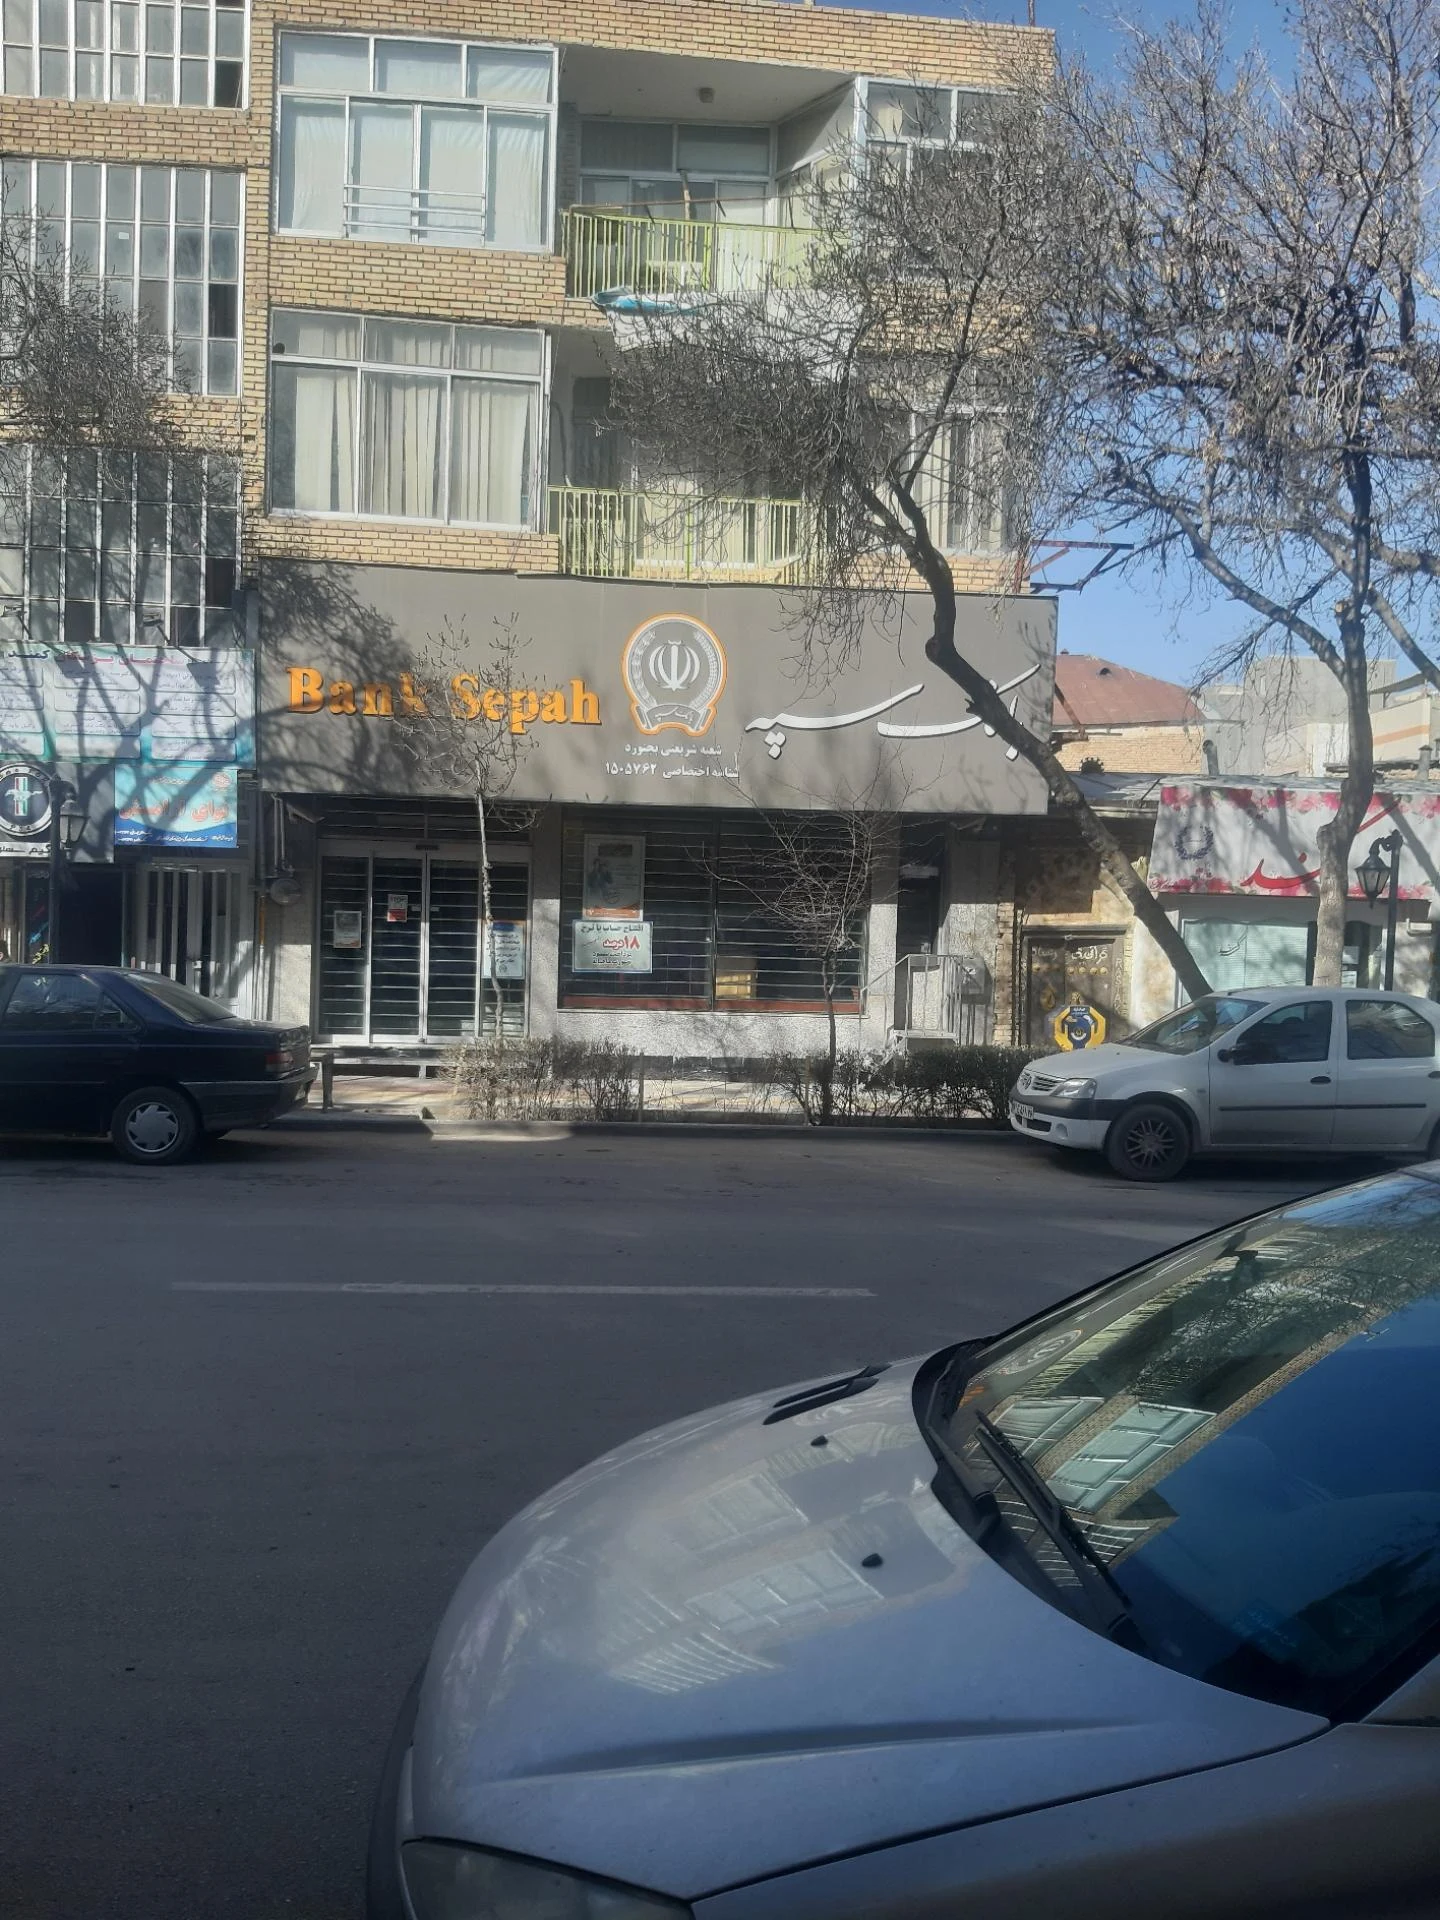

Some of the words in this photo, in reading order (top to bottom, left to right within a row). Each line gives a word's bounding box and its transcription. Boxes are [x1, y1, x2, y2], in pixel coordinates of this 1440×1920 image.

[286, 667, 431, 717] Bank
[451, 673, 602, 735] Sepah
[744, 683, 924, 760] سپه
[660, 744, 697, 757] شریعتی
[700, 744, 722, 756] شعبه
[606, 761, 657, 775] ۱۵۰۵۷۶۲
[662, 764, 710, 779] اختصاصی
[603, 938, 624, 950] درصد
[624, 935, 641, 949] ۱۸
